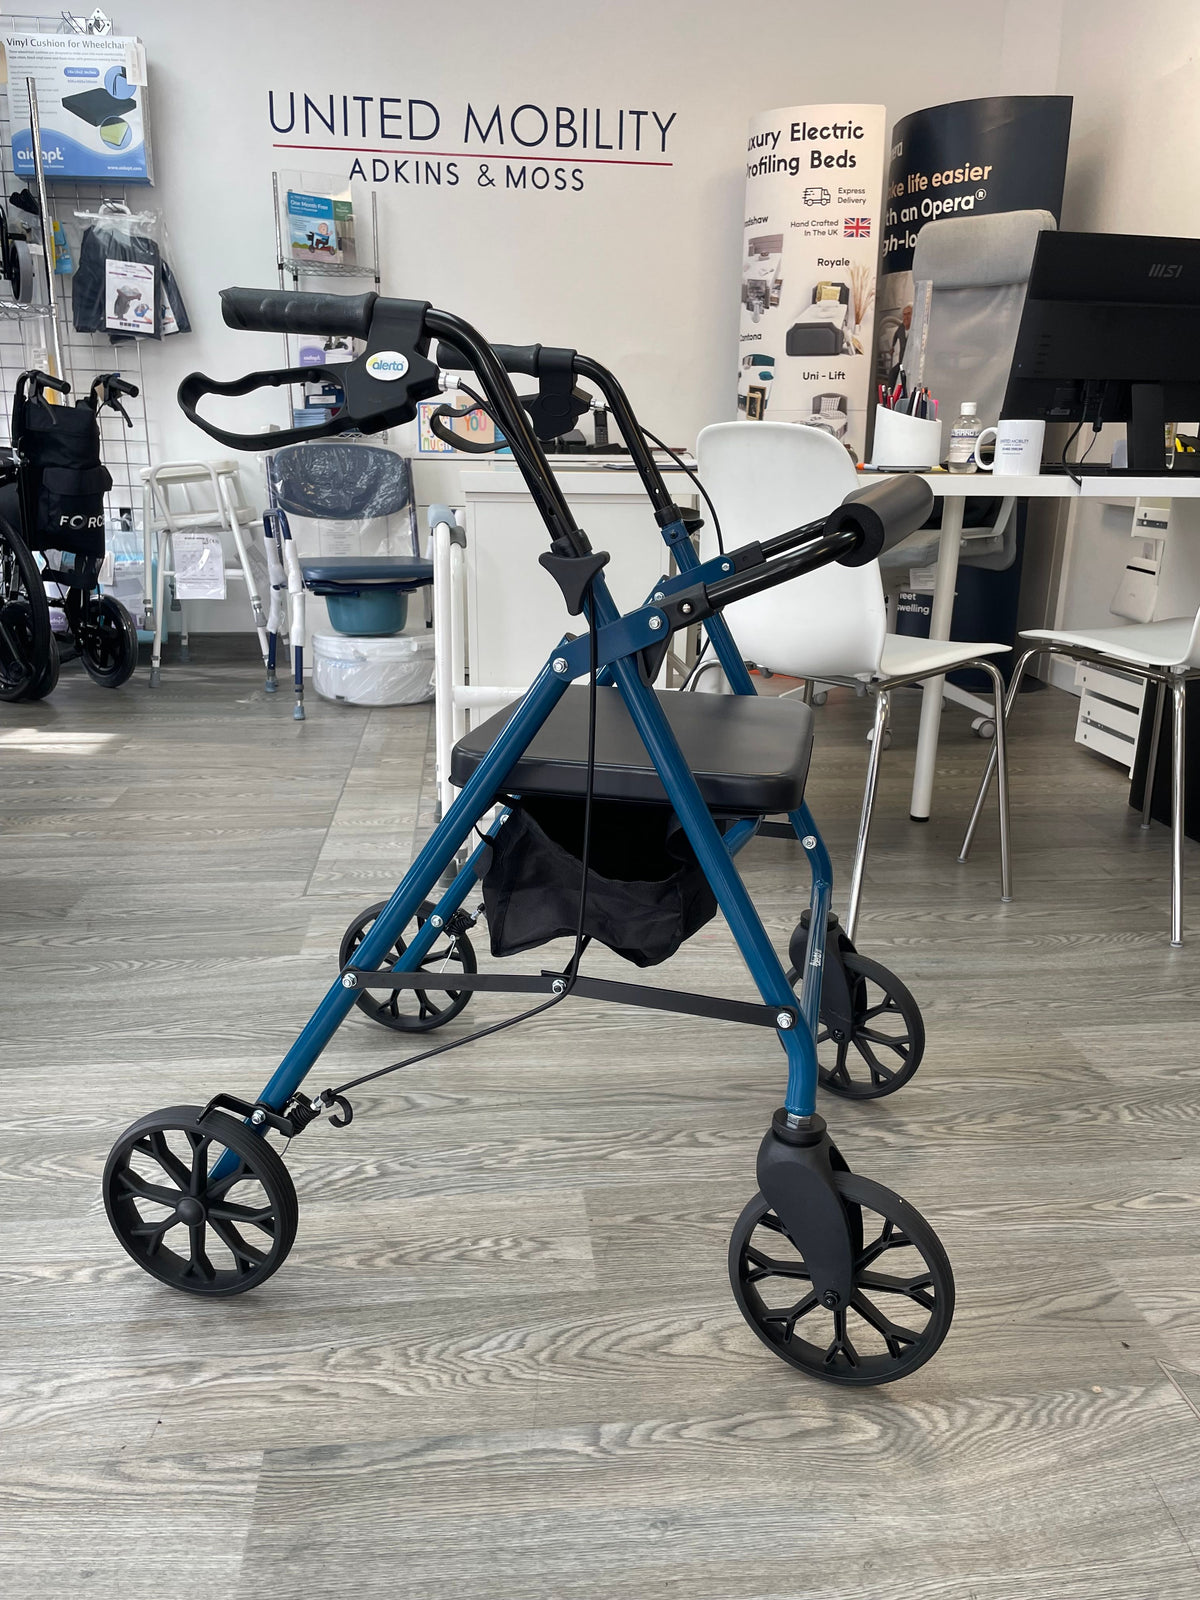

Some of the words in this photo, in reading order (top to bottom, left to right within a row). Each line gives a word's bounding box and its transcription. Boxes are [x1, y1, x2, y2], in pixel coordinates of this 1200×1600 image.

[6, 38, 28, 48] Vinyl
[30, 39, 66, 48] Cushion
[67, 40, 80, 48] for
[82, 40, 127, 49] Wheelchai
[268, 90, 440, 141] UNITED
[464, 103, 677, 152] MOBILITY
[790, 120, 864, 142] Electric
[810, 149, 857, 169] Beds
[349, 158, 460, 186] ADKINS
[477, 164, 496, 188] &
[506, 165, 585, 191] MOSS
[907, 172, 928, 194] life
[931, 162, 993, 187] easier
[837, 187, 866, 196] Express
[837, 197, 867, 206] Delivery
[900, 206, 918, 222] an
[790, 220, 810, 228] Hand
[811, 219, 839, 228] Crafted
[803, 229, 811, 237] In
[817, 257, 851, 269] Royale
[1148, 263, 1184, 279] MSI
[372, 359, 404, 372] alerta
[802, 371, 819, 381] Uni
[828, 370, 846, 380] Lift
[464, 415, 487, 432] YOU
